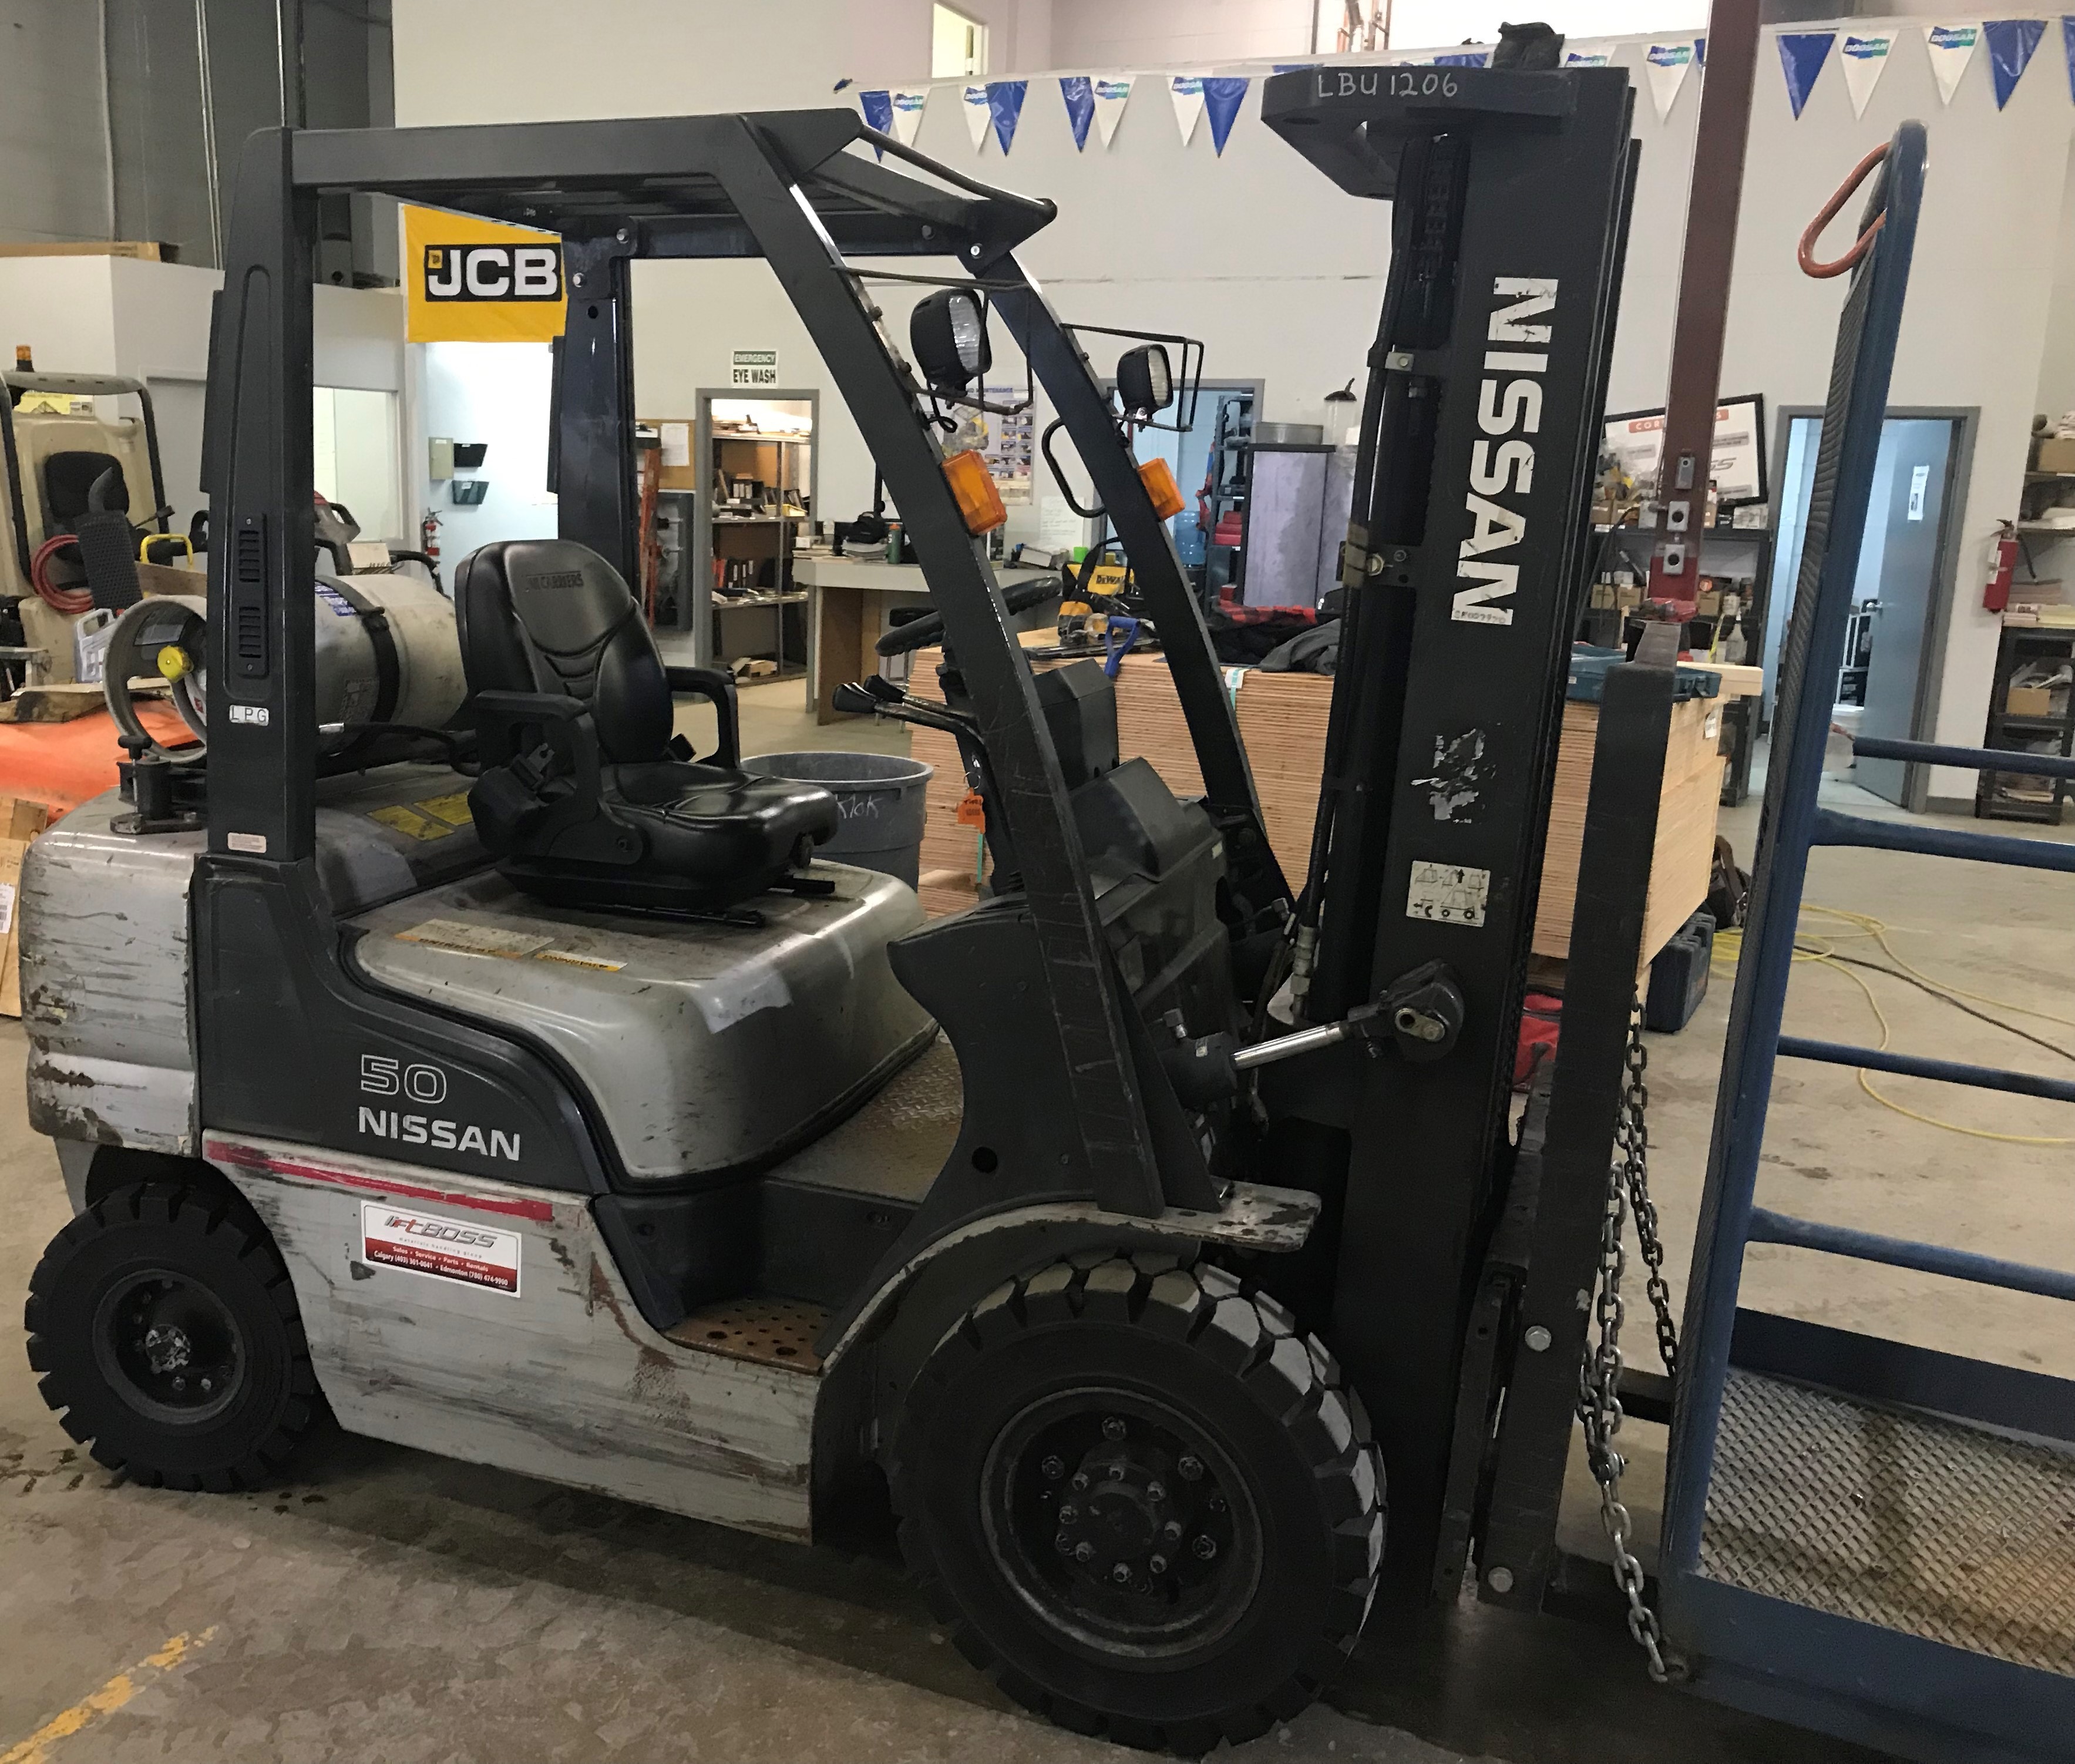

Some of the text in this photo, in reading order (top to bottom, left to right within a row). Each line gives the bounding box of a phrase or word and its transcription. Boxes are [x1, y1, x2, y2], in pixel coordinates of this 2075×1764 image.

[1318, 72, 1458, 98] LBU 1206
[427, 248, 559, 297] JCB
[734, 354, 775, 363] EMERGENCY
[733, 369, 776, 384] EYE WASH
[1451, 277, 1559, 626] NISSAN
[231, 705, 267, 723] LPG
[361, 1054, 448, 1104] 50
[358, 1106, 521, 1161] NISSAN
[374, 1250, 394, 1262] Calgary
[440, 1264, 468, 1276] Edmonton
[392, 1245, 489, 1272] Sales Service Parts Rentals
